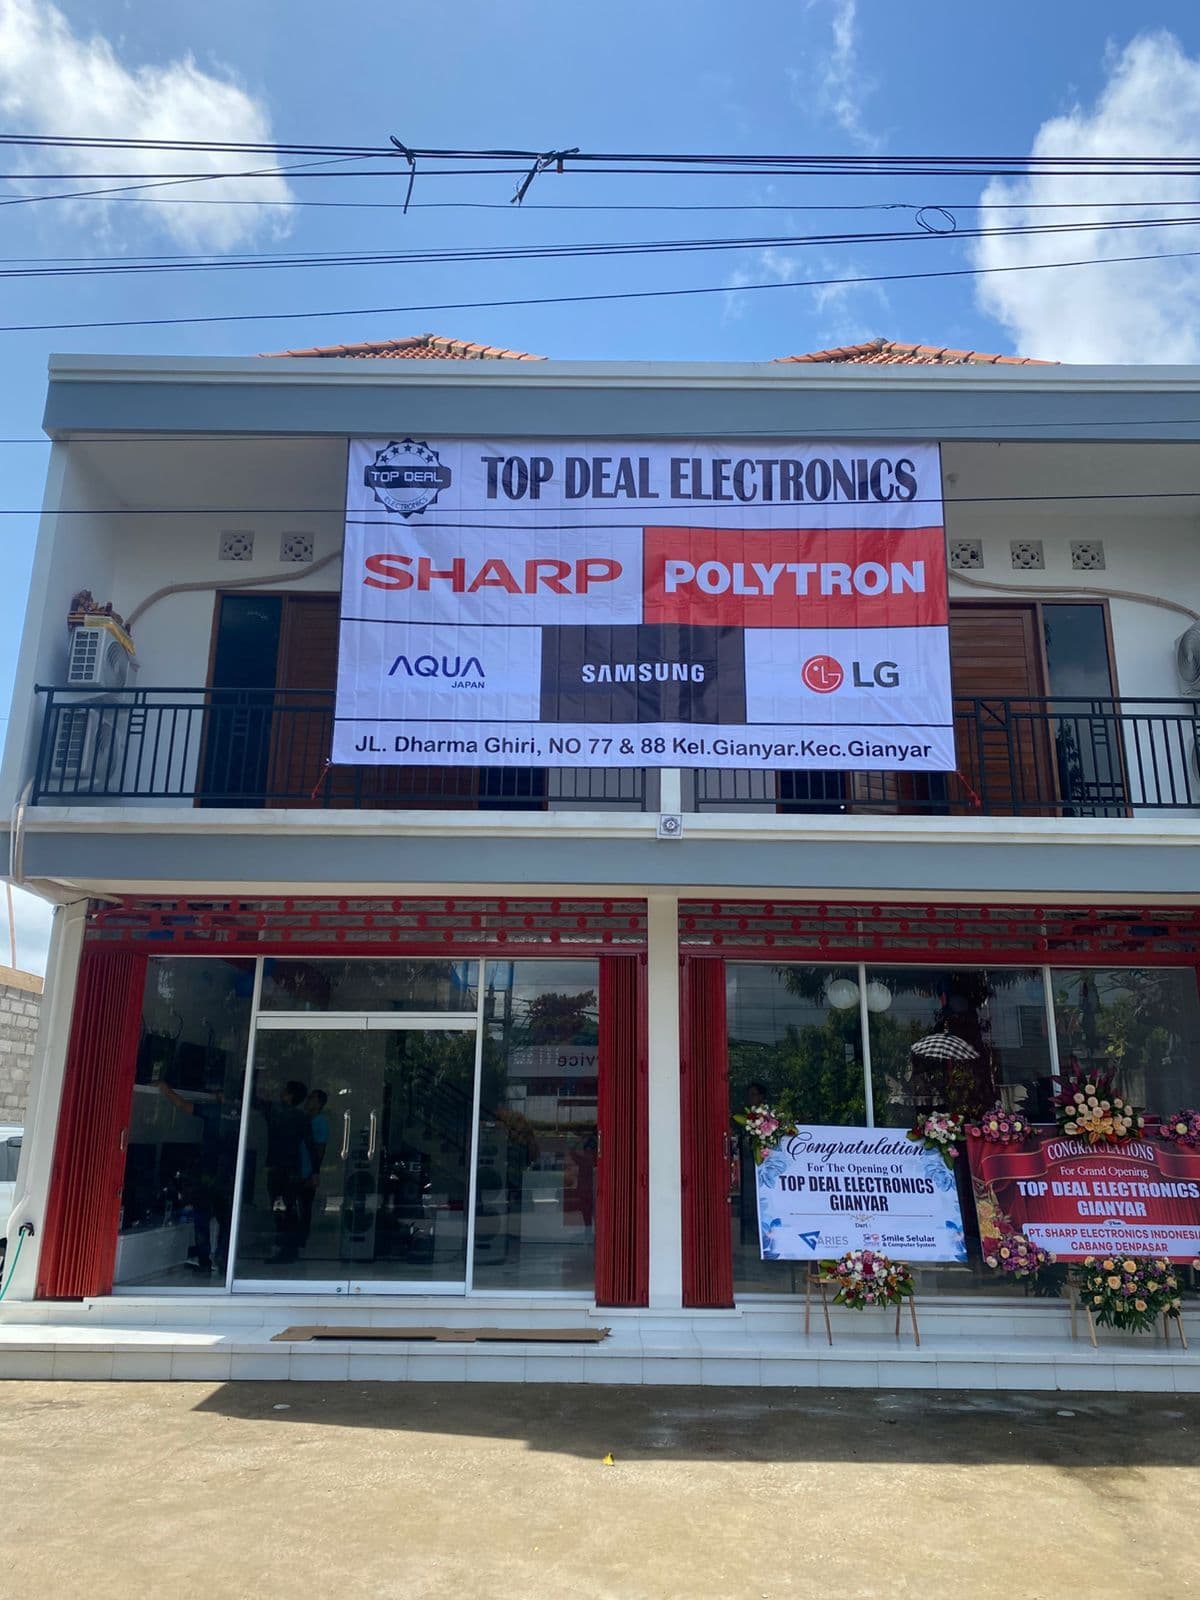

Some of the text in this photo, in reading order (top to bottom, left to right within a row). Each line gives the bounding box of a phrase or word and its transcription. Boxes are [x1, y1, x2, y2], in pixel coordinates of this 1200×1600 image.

[371, 471, 443, 482] TOP DEAL
[481, 456, 918, 502] TOP DEAL ELECTRONICS
[363, 553, 623, 594] SHARP
[664, 559, 926, 596] POLYTRON
[388, 655, 485, 678] AQUA
[581, 663, 706, 683] SAMSUNG
[852, 661, 900, 688] LG
[451, 681, 485, 689] JAPAN
[355, 736, 386, 752] JL.
[394, 736, 478, 753] Dharma
[484, 737, 542, 756] Ghiri,
[549, 738, 582, 754] NO
[588, 739, 613, 754] 77
[619, 739, 634, 754] &
[640, 738, 666, 753] 88
[807, 1162, 904, 1175] For The Opening Of
[1060, 1166, 1150, 1178] For Grand Opening
[779, 1175, 935, 1194] TOP DEAL ELECTRONICS
[1016, 1181, 1200, 1199] TOP DEAL ELECTRONICS
[830, 1194, 890, 1211] GIANYAR
[1077, 1201, 1148, 1217] GIANYAR
[881, 1234, 905, 1242] Smile
[1029, 1229, 1200, 1240] PT. SHARP ELECTRONICS INDONESI
[1071, 1241, 1169, 1252] CABANG DENPASAR
